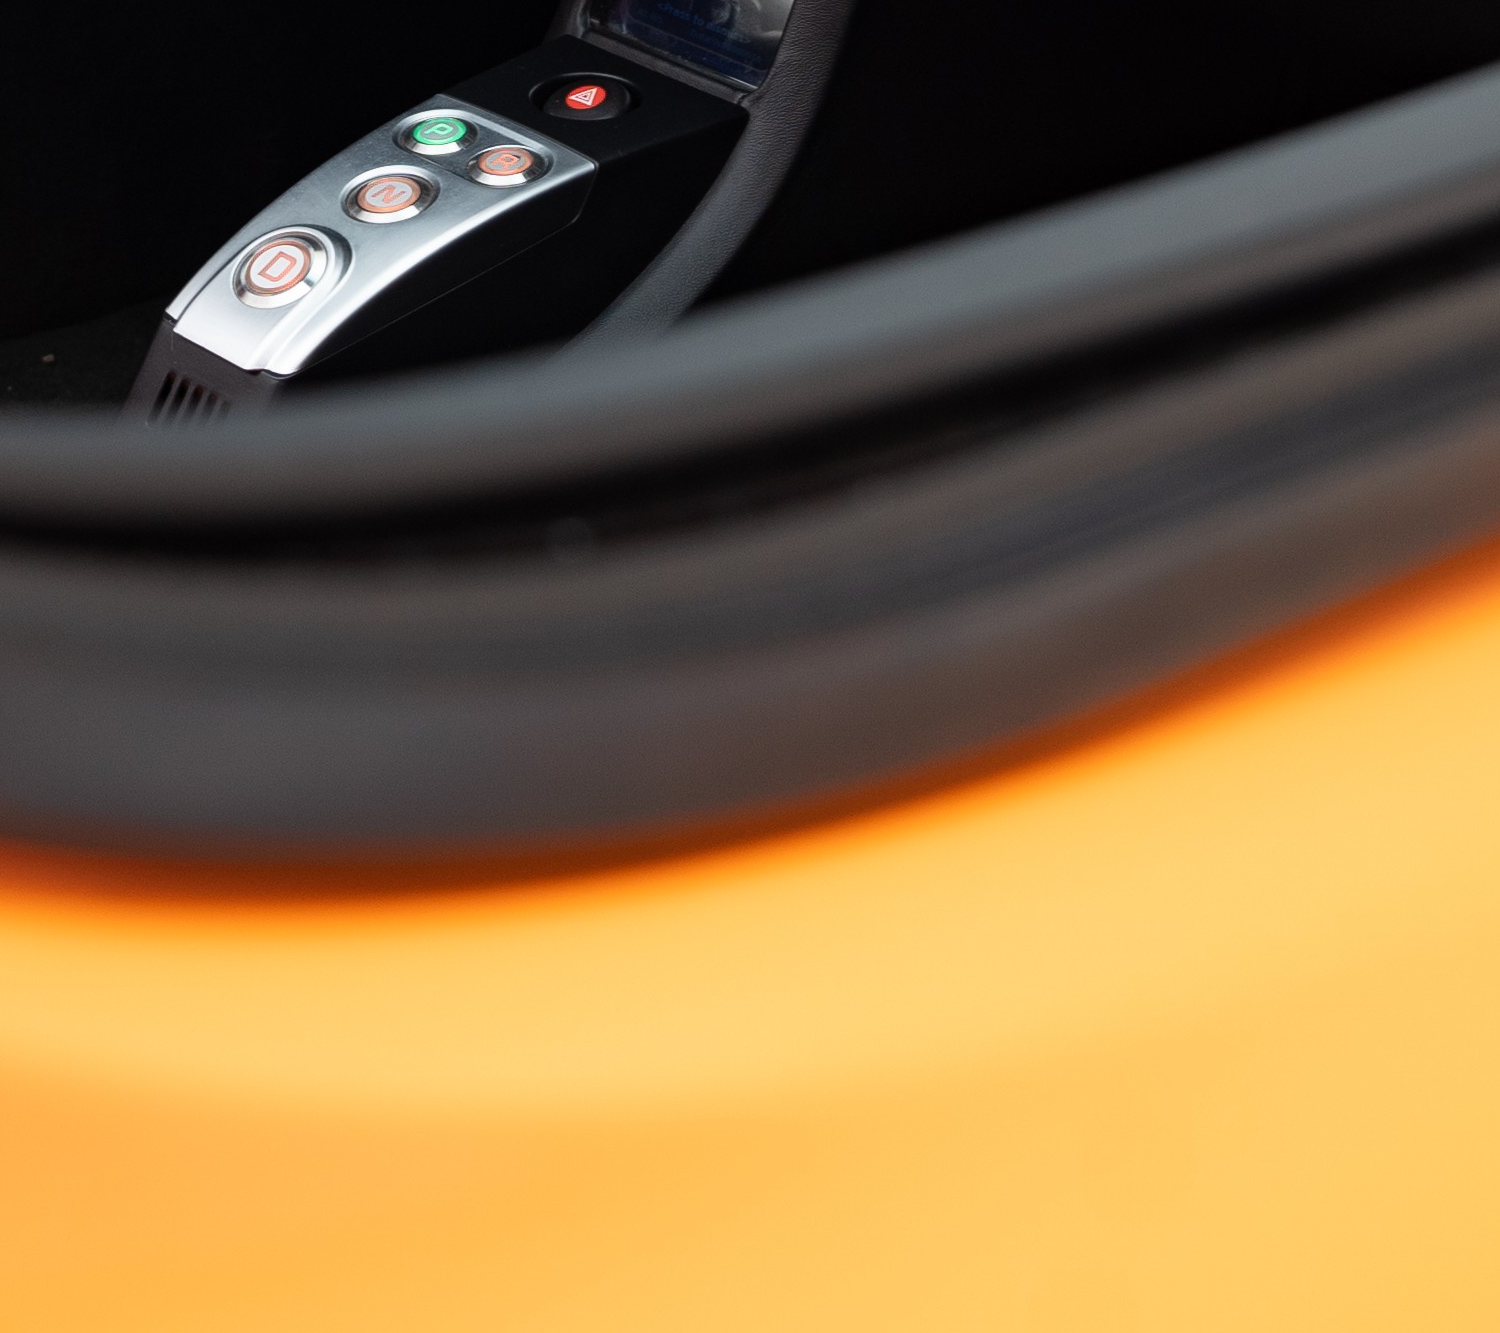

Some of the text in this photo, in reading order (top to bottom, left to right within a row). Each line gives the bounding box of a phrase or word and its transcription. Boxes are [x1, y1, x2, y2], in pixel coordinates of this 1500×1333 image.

[423, 122, 454, 138] P
[489, 153, 520, 170] R
[371, 184, 406, 204] N
[257, 251, 298, 282] D
